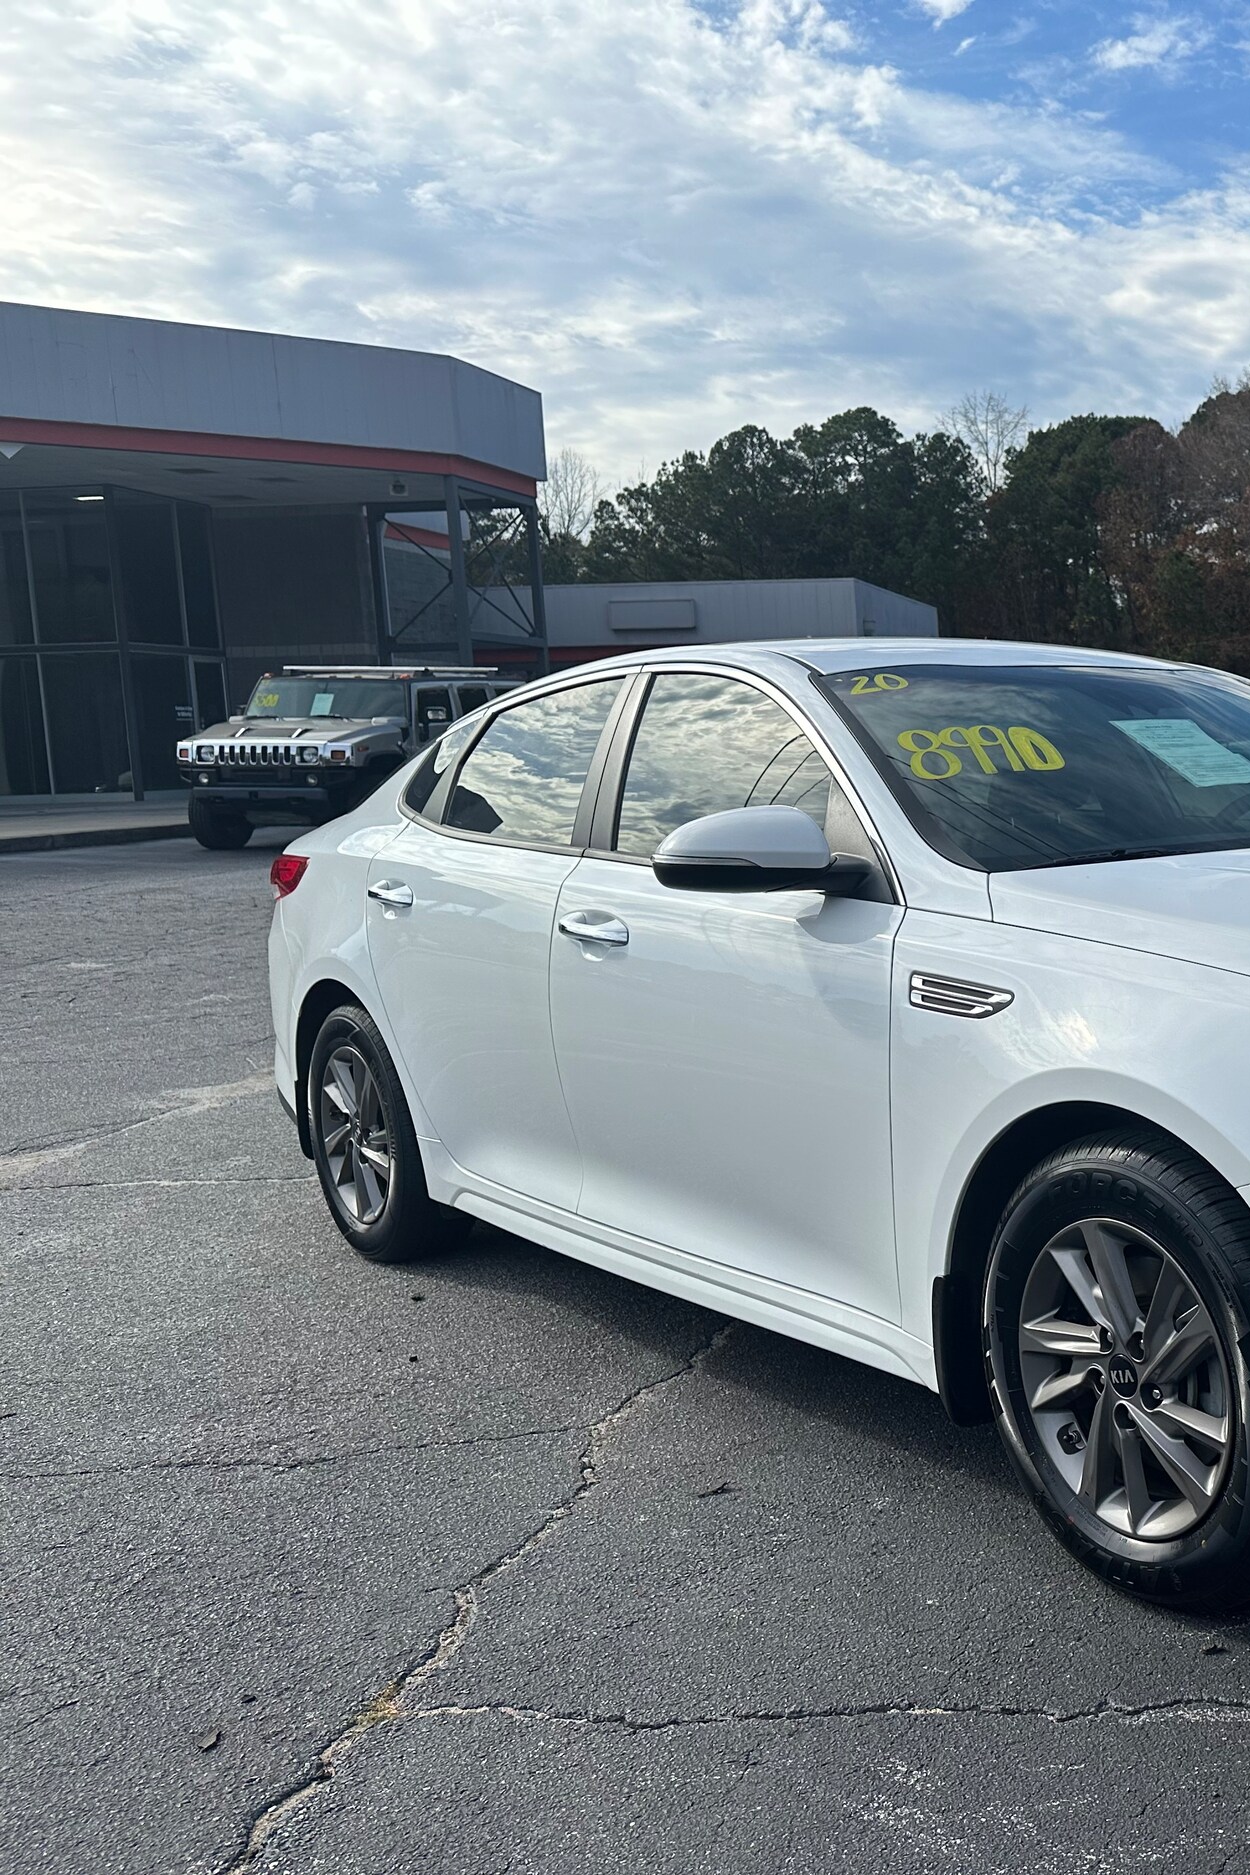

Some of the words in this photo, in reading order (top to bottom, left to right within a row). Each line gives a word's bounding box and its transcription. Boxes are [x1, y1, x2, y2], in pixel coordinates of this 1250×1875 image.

[850, 673, 909, 695] 20
[897, 725, 1066, 780] 8990
[1047, 1171, 1165, 1219] FORCE
[1110, 1369, 1135, 1384] KIA
